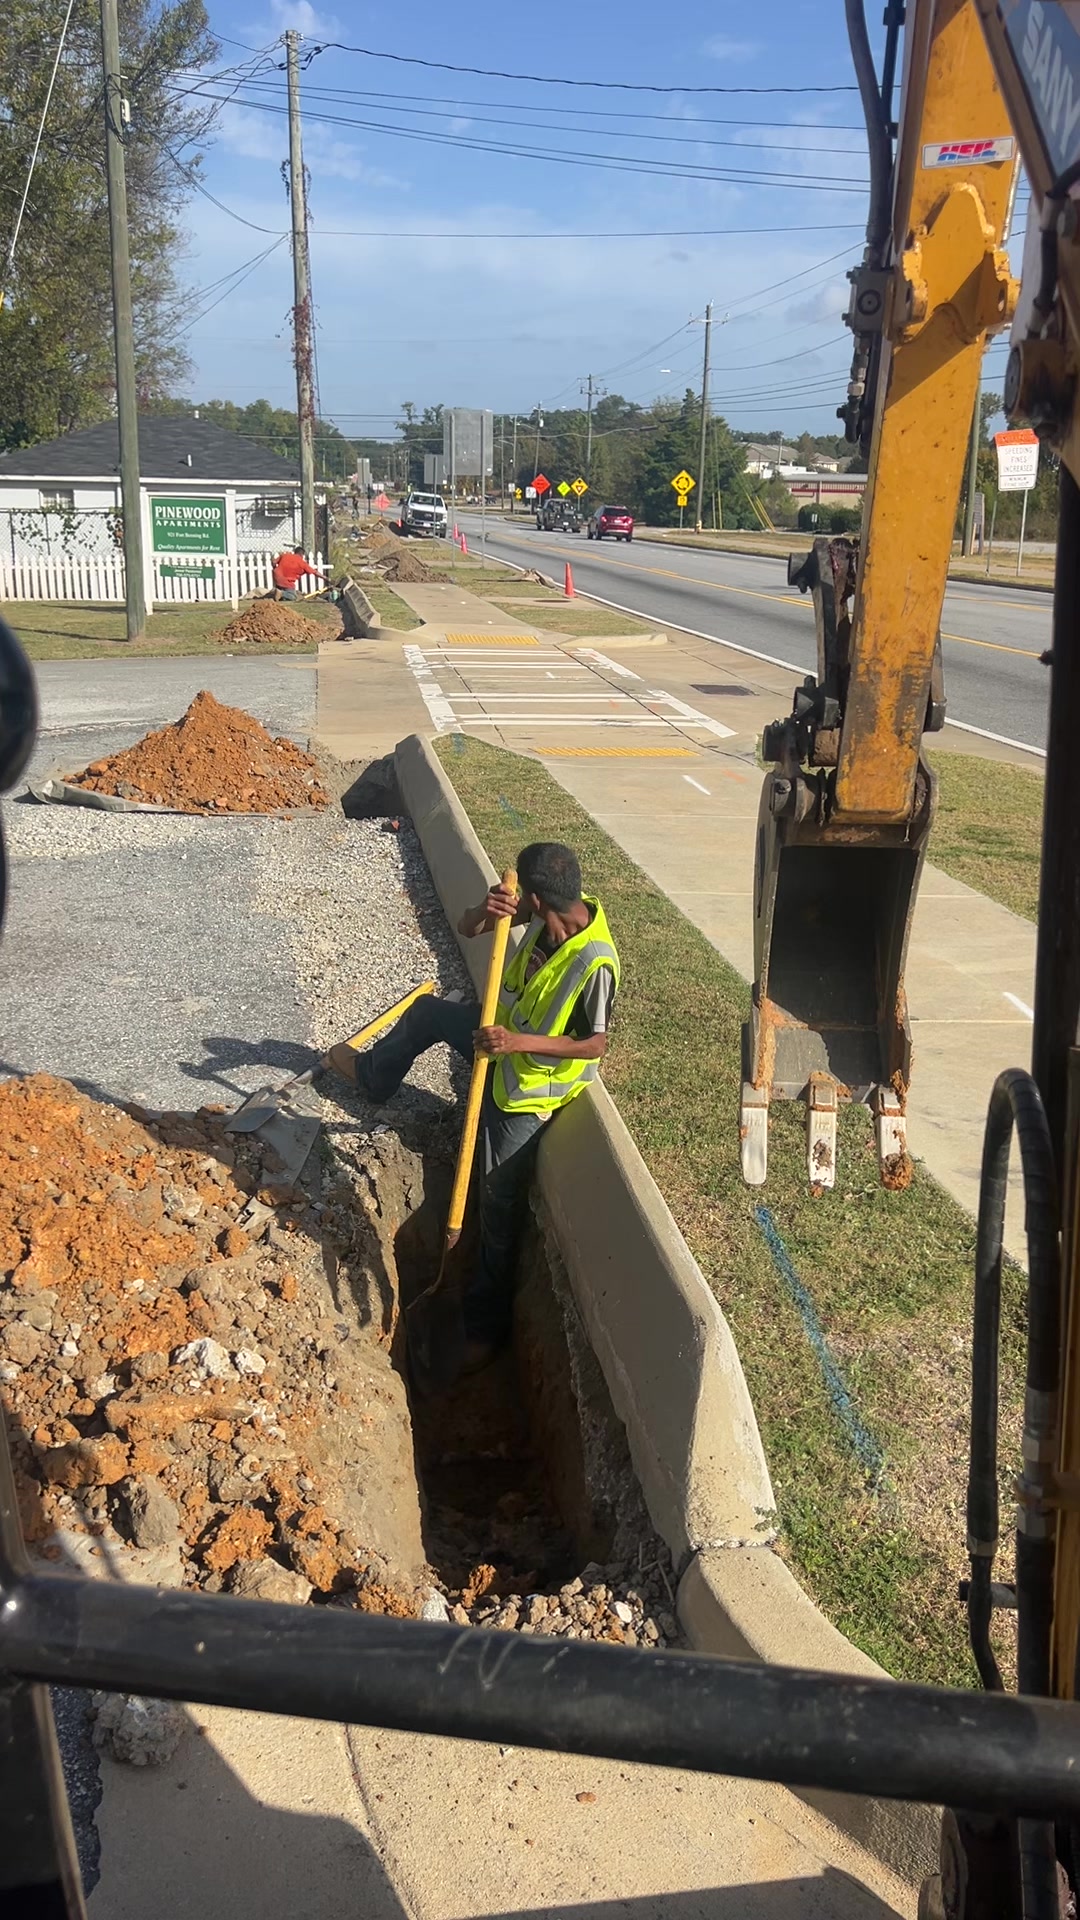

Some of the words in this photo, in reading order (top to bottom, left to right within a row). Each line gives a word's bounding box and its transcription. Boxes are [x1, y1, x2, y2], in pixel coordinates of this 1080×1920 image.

[1022, 1, 1080, 158] SANY
[1004, 447, 1033, 455] SPEEDING
[1004, 465, 1033, 473] INCREASED
[155, 506, 221, 519] PINEWOOD
[156, 520, 221, 528] APARTMENTS
